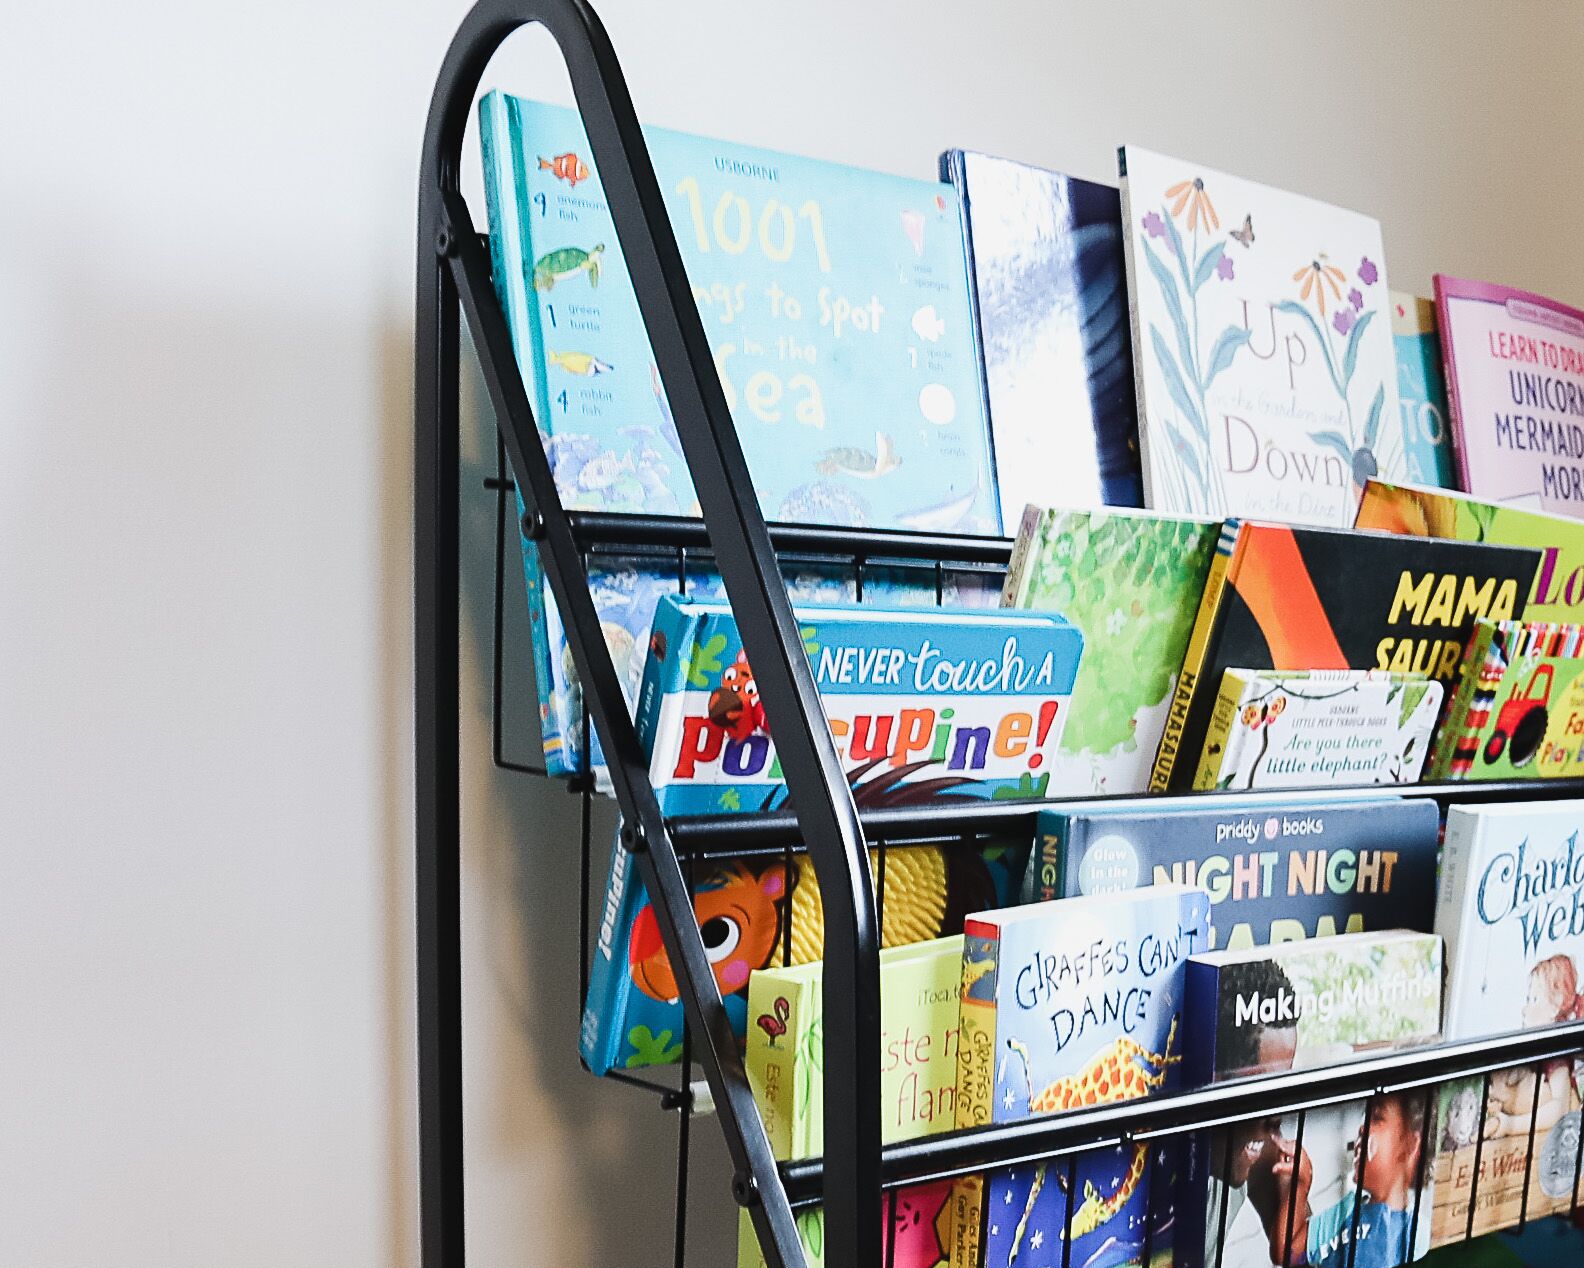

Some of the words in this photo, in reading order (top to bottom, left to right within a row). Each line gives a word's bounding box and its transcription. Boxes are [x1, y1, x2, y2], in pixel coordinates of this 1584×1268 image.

[675, 176, 832, 273] 1001
[545, 304, 557, 328] 1
[568, 303, 601, 317] green
[767, 280, 801, 321] to
[1239, 298, 1307, 390] Up
[1489, 330, 1538, 364] LEARN
[1541, 340, 1559, 370] TO
[556, 388, 569, 415] 4
[579, 388, 614, 403] rabbit
[1223, 415, 1345, 487] Down
[1387, 570, 1518, 628] MAMA
[817, 646, 905, 685] NEVER
[907, 636, 1035, 692] touch
[1035, 651, 1054, 686] A
[1376, 637, 1467, 681] SAUR
[672, 699, 1059, 780] poupine!
[1283, 733, 1312, 751] Are
[1316, 738, 1341, 756] you
[1345, 735, 1383, 750] there
[1266, 757, 1306, 774] little
[1310, 753, 1388, 779] elephant?
[1216, 818, 1261, 845] priddy
[1282, 815, 1324, 836] books
[1153, 850, 1280, 905] NIGHT
[1286, 848, 1399, 897] NIGHT
[1015, 939, 1129, 1010] GIRAFFES
[1050, 987, 1151, 1055] DANCE
[1234, 985, 1334, 1028] Making
[880, 1026, 931, 1073] ste
[1492, 1147, 1527, 1178] Whit
